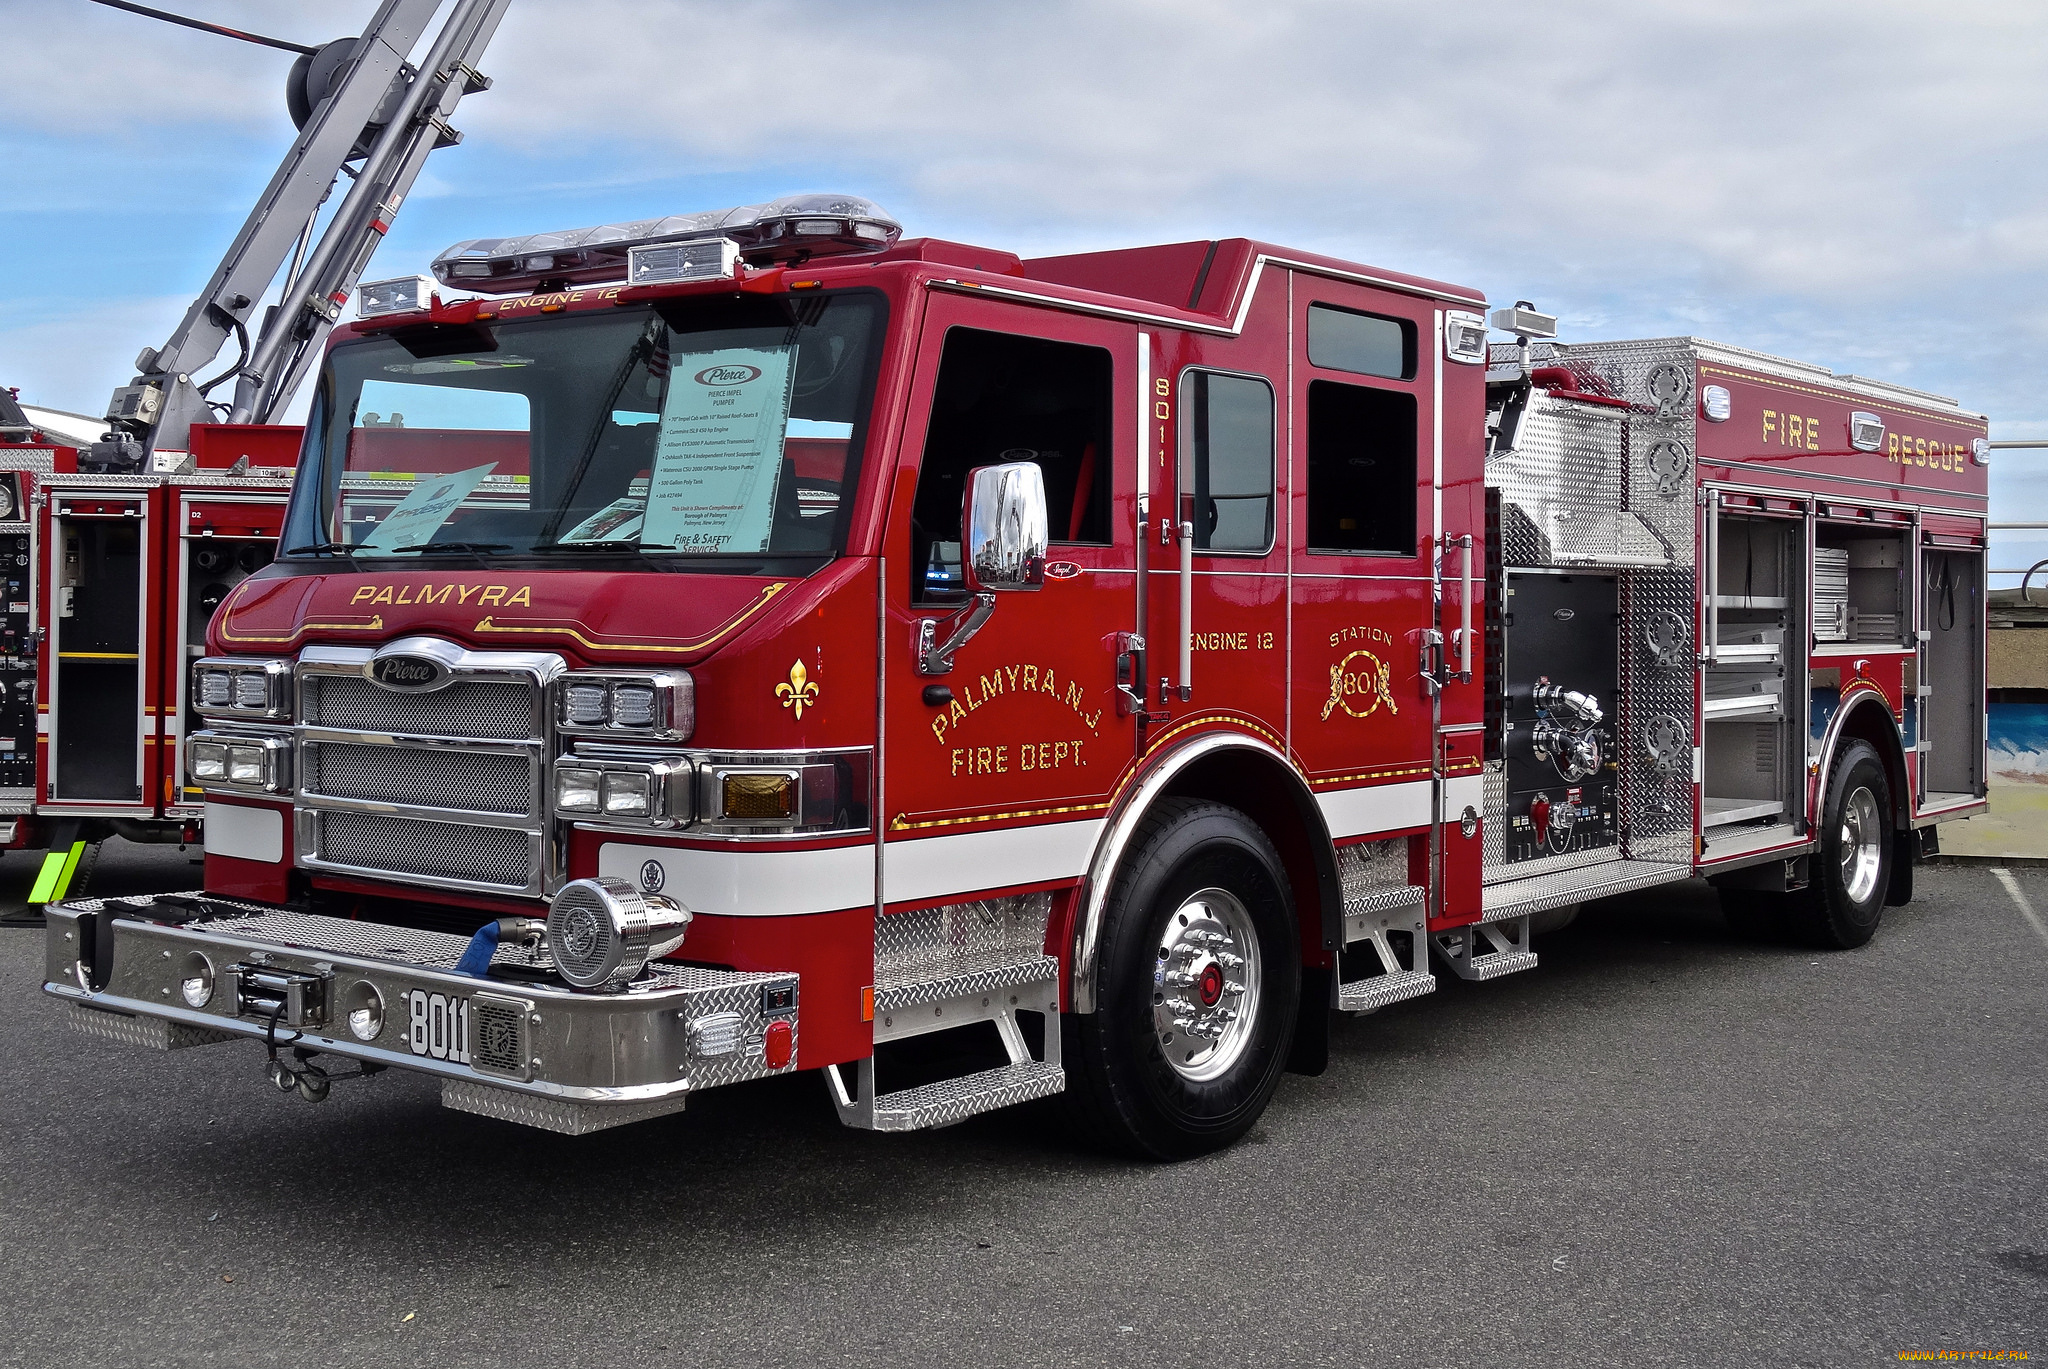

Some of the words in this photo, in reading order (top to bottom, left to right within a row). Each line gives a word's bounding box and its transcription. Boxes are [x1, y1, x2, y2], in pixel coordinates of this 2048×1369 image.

[500, 292, 584, 311] ENGINE
[597, 287, 622, 300] 12
[709, 368, 745, 383] Pierce
[708, 390, 726, 398] PIERCE
[726, 389, 742, 397] IMPEL
[712, 398, 735, 406] PUMPER
[1762, 409, 1820, 451] FIRE
[1888, 432, 1964, 474] RESCUE
[696, 452, 722, 460] Independent
[714, 464, 728, 472] Single
[728, 464, 740, 472] Stage
[708, 504, 737, 512] Compliments
[692, 533, 700, 544] &
[350, 584, 532, 608] PALMYRA
[1256, 632, 1274, 650] 12
[1329, 626, 1393, 648] STATION
[381, 658, 430, 680] Pierce
[1343, 672, 1378, 695] 801
[952, 745, 1008, 776] FIRE
[1020, 740, 1087, 771] DEPT.
[409, 989, 470, 1064] 8011
